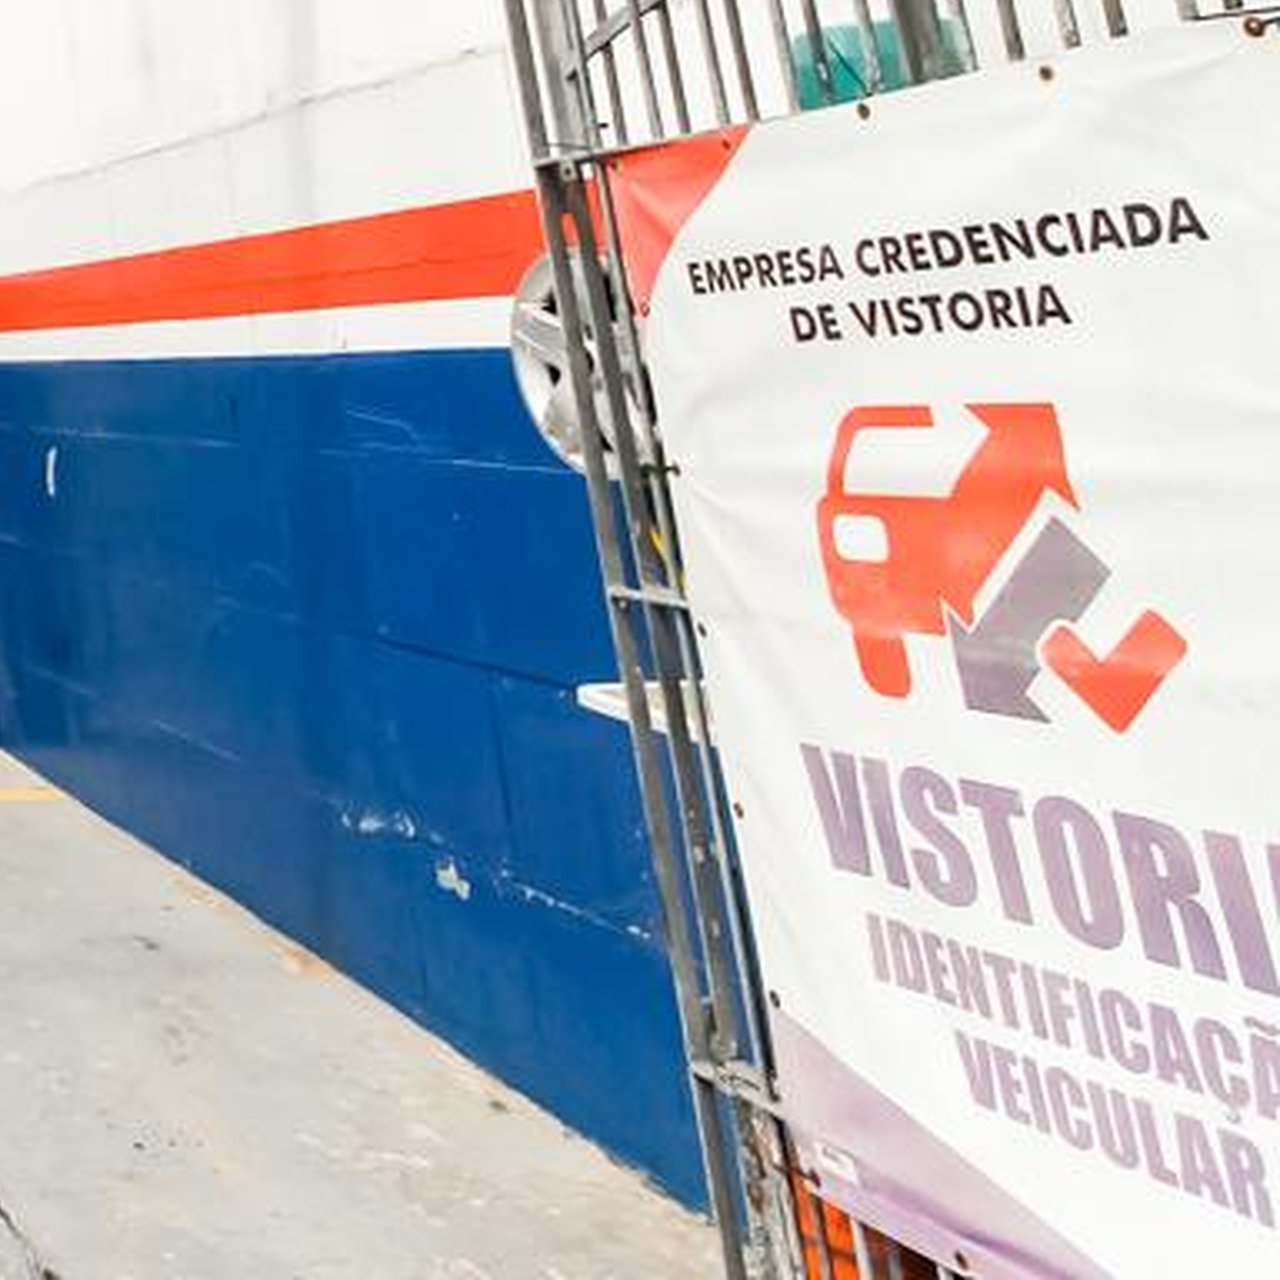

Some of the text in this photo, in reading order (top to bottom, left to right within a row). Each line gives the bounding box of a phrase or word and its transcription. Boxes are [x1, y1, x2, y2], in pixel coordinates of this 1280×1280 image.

[687, 196, 1209, 295] EMPRESA CREDENCIADA
[789, 284, 1073, 343] DE VISTORIA
[800, 743, 1280, 997] VISTORI
[956, 1030, 1275, 1227] VEICULAR
